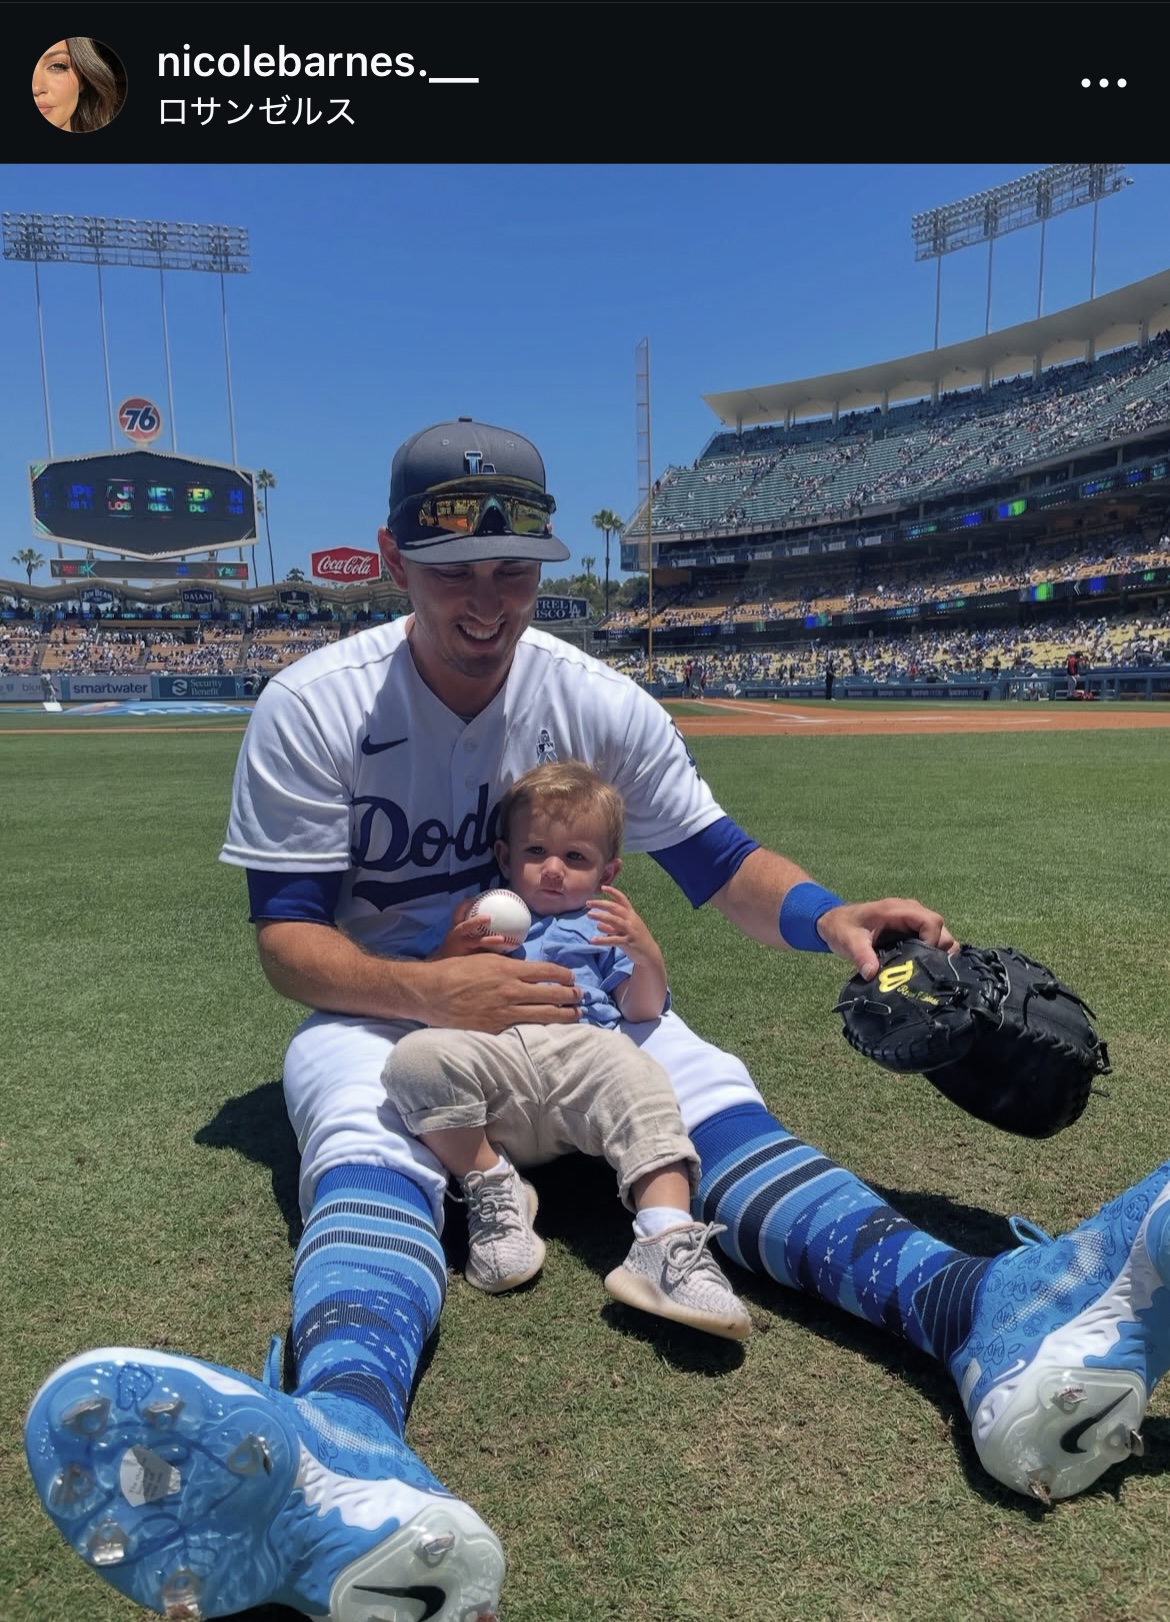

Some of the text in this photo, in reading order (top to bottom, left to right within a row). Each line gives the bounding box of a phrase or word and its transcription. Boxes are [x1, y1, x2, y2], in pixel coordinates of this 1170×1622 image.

[124, 406, 156, 432] 76
[317, 555, 373, 575] Coca-Cola
[73, 682, 148, 694] smartwater
[190, 679, 222, 689] Security
[191, 688, 218, 696] Benefit
